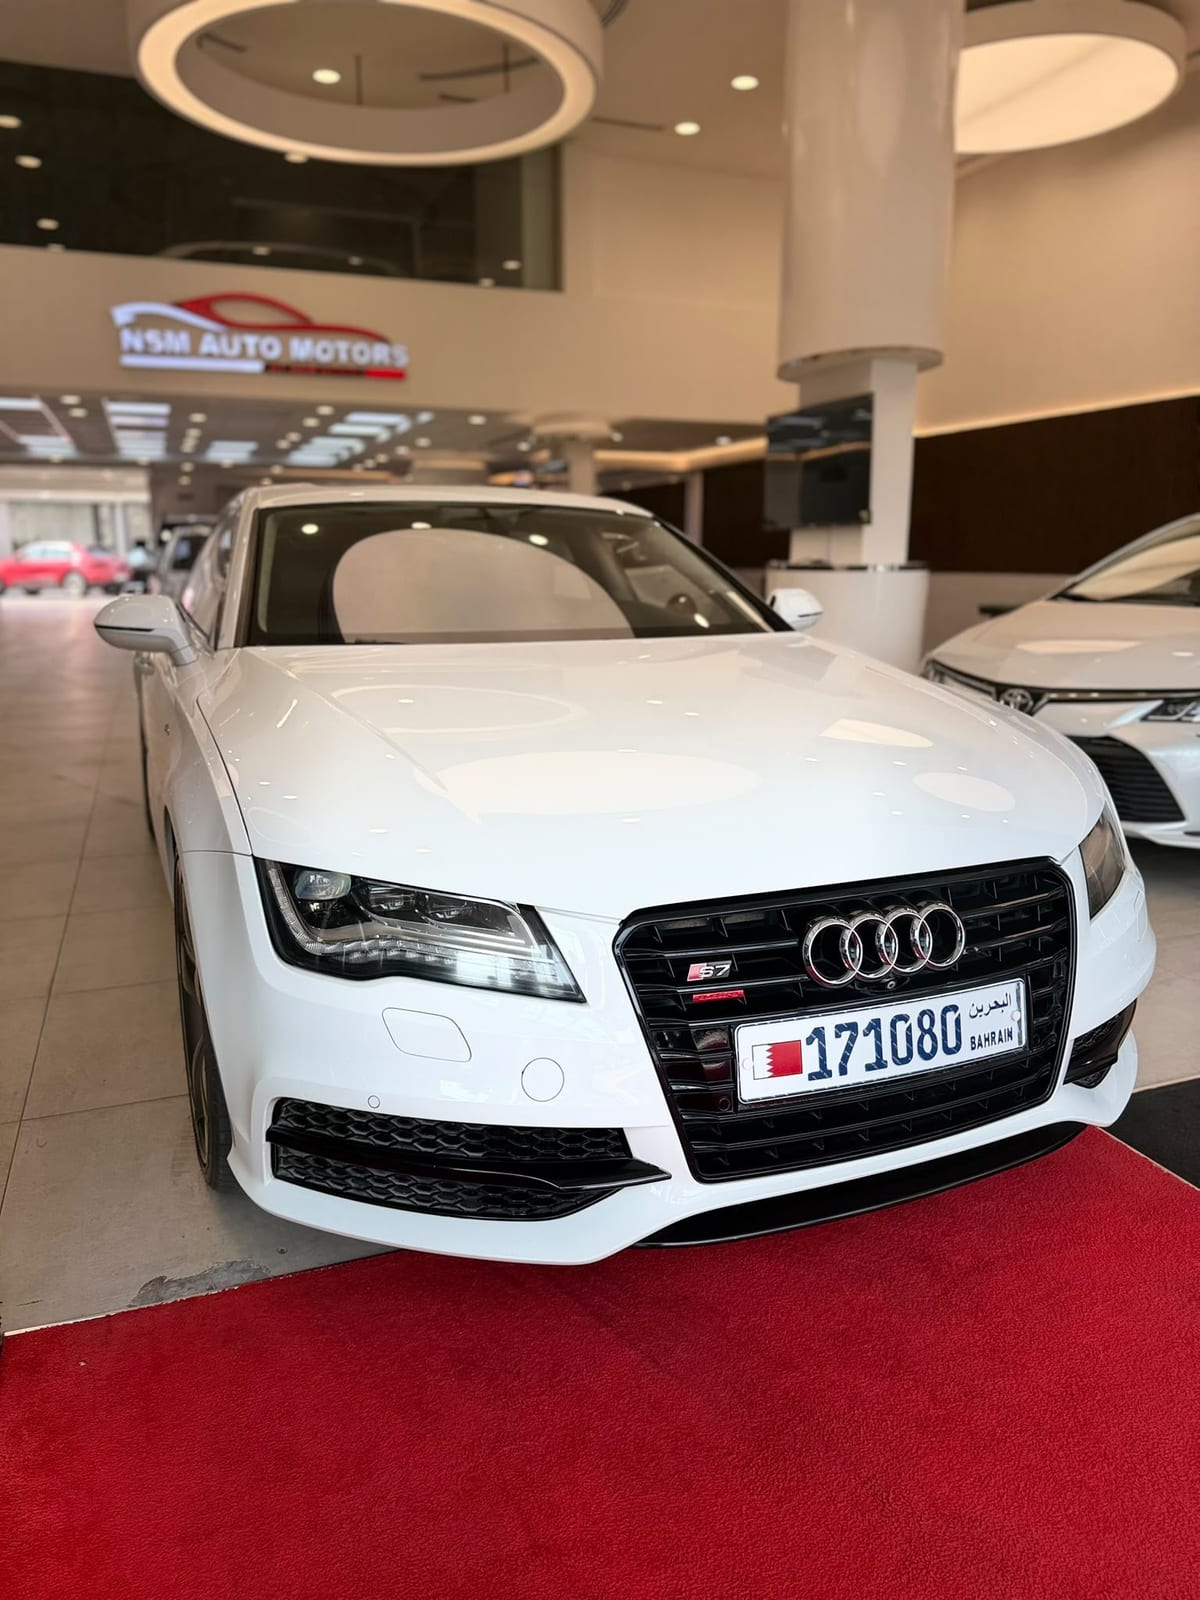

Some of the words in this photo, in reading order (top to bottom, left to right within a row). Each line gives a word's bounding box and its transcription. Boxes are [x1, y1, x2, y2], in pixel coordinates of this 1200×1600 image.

[120, 328, 191, 355] NSM
[199, 333, 282, 360] AUTO
[289, 336, 410, 367] MOTORS
[700, 964, 731, 978] S7
[968, 992, 1012, 1019] البحرين
[805, 1003, 963, 1081] 171080
[970, 1026, 1013, 1051] BAHRAIN
